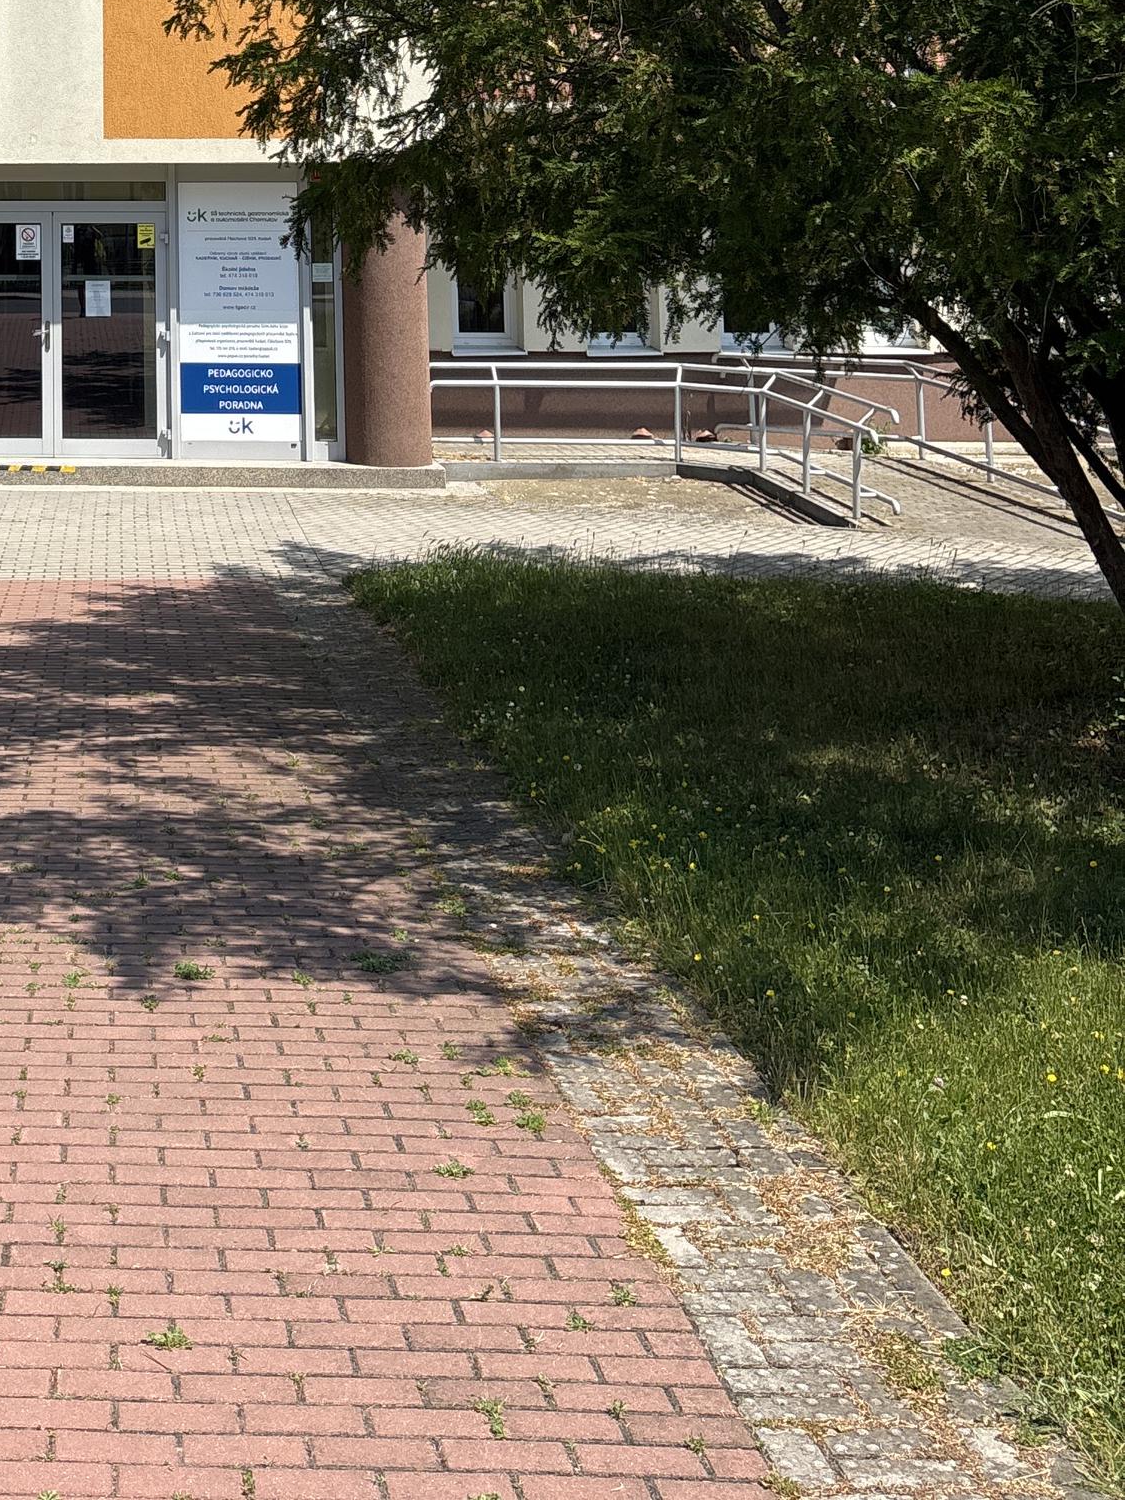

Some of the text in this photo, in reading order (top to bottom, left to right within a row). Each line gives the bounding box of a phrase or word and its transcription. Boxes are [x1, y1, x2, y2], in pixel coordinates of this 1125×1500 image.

[207, 368, 274, 378] PEDAGOGICKO
[203, 383, 279, 394] PSYCHOLOGICKÁ
[219, 400, 264, 410] PORADNA
